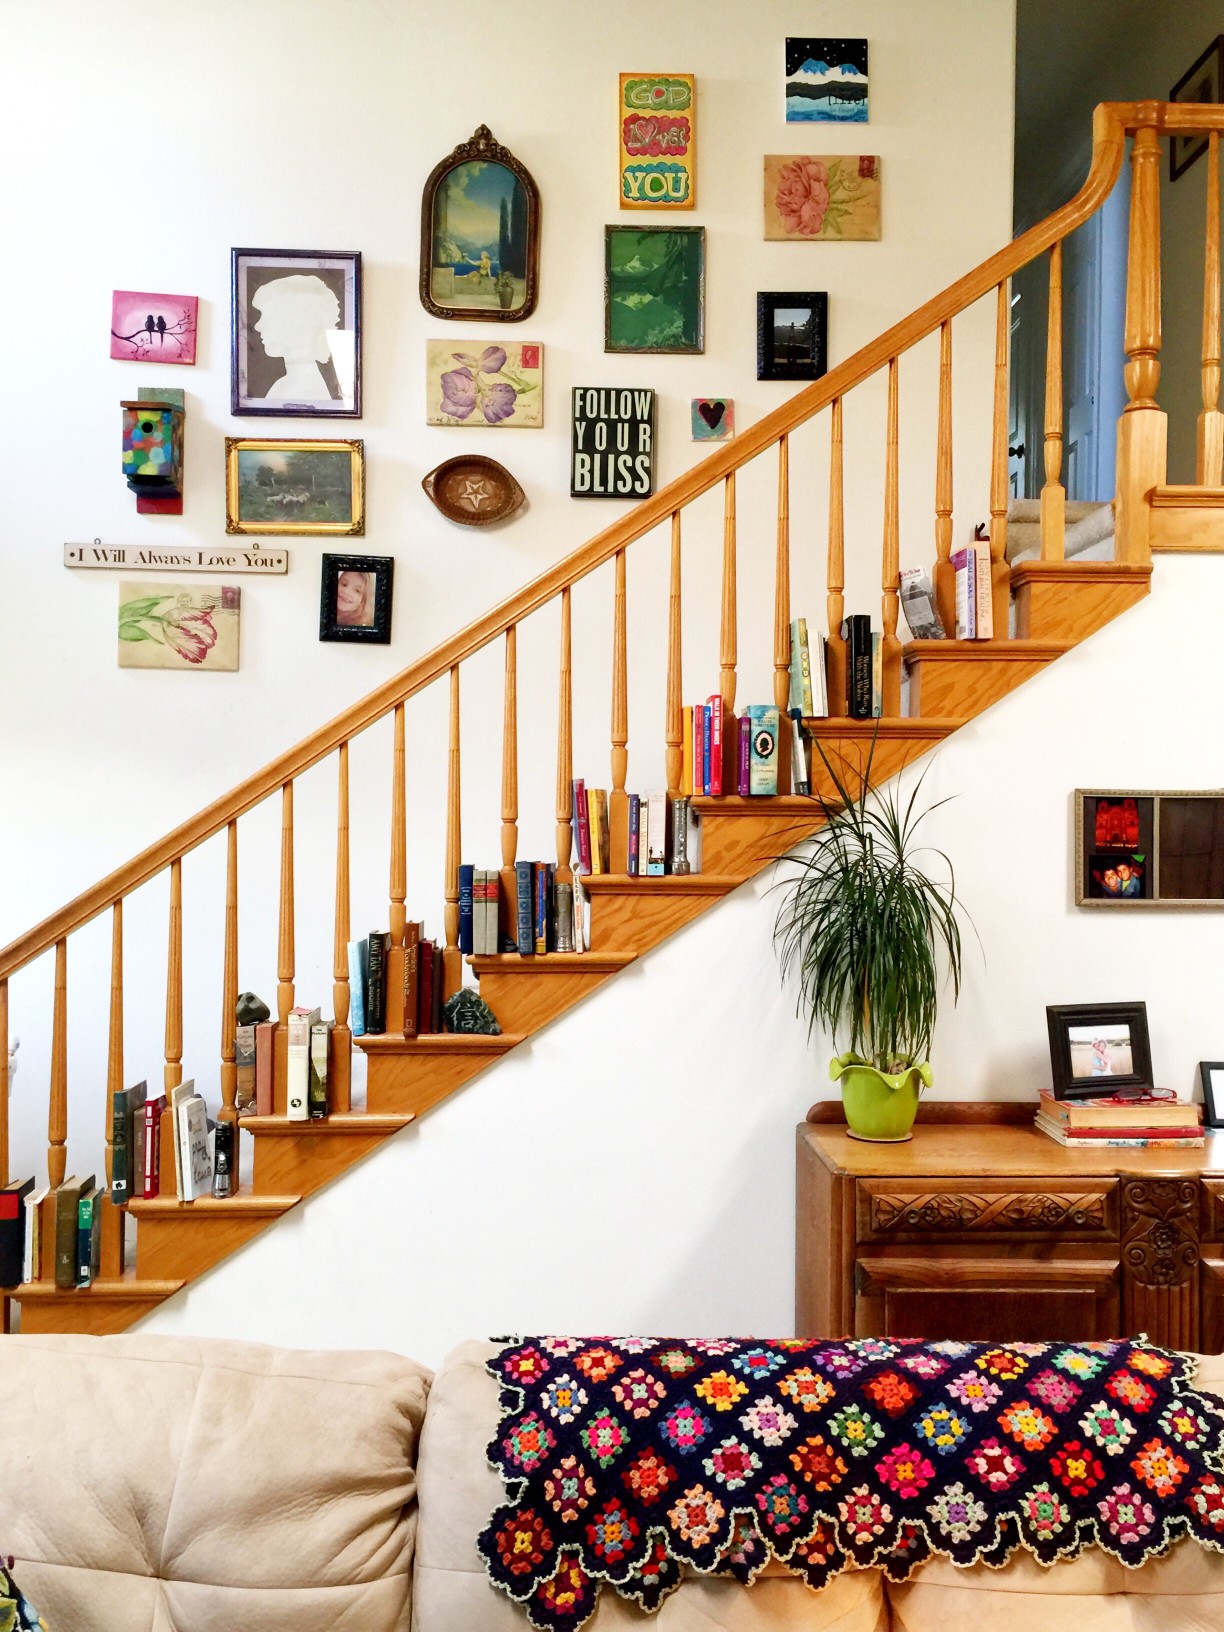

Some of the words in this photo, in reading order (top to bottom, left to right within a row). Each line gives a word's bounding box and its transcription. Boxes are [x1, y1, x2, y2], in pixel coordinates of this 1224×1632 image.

[631, 84, 689, 105] GOD
[625, 171, 688, 198] YOU
[575, 389, 651, 420] FOLLOW
[575, 422, 651, 452] YOUR
[574, 453, 650, 494] BLISS
[78, 548, 84, 562] I
[92, 548, 126, 563] Will
[134, 550, 191, 565] Always
[197, 552, 236, 566] Love
[242, 553, 275, 568] You
[370, 938, 381, 956] AMY
[370, 955, 381, 971] TAN
[450, 1003, 477, 1028] 信
